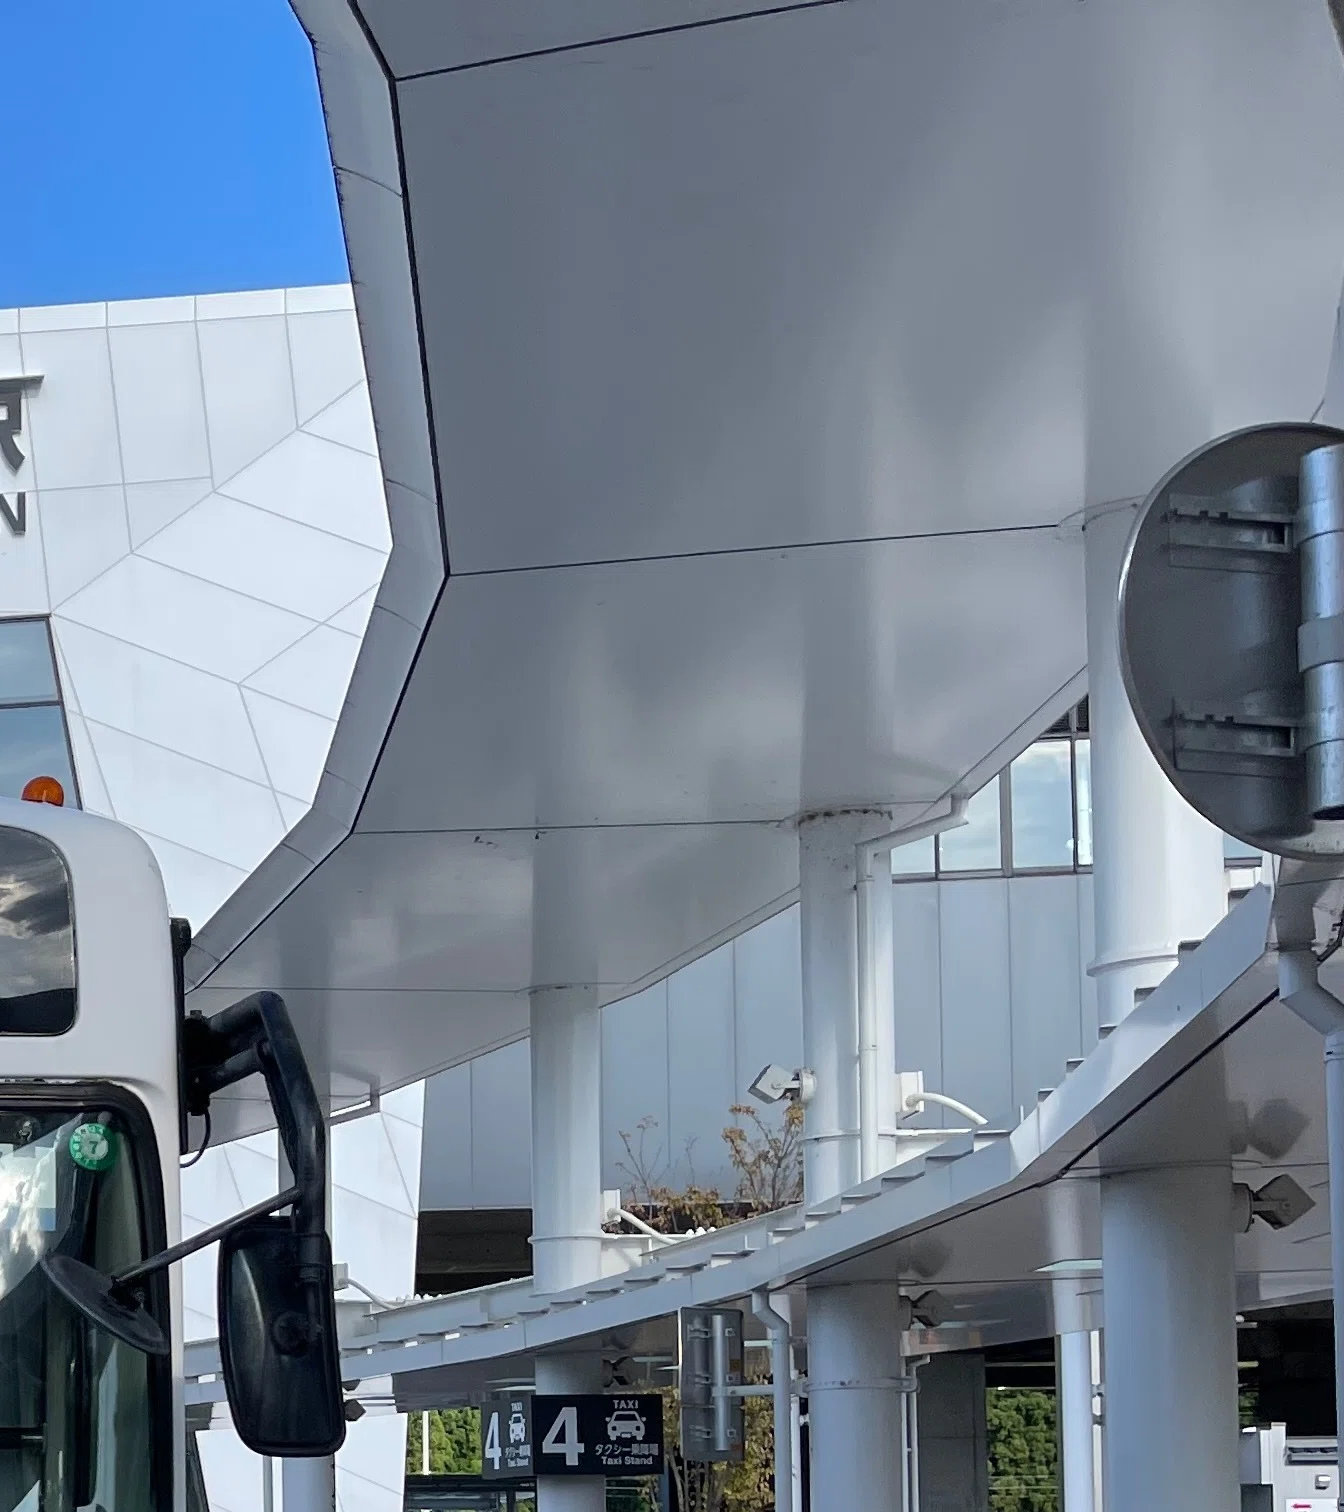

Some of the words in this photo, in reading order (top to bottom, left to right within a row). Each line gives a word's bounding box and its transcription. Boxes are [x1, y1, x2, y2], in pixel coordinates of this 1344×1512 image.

[88, 1140, 99, 1155] 7
[613, 1399, 639, 1409] TAXI
[485, 1411, 502, 1470] 4
[542, 1406, 585, 1466] 4
[601, 1455, 623, 1465] Taxi
[624, 1455, 653, 1465] Stand
